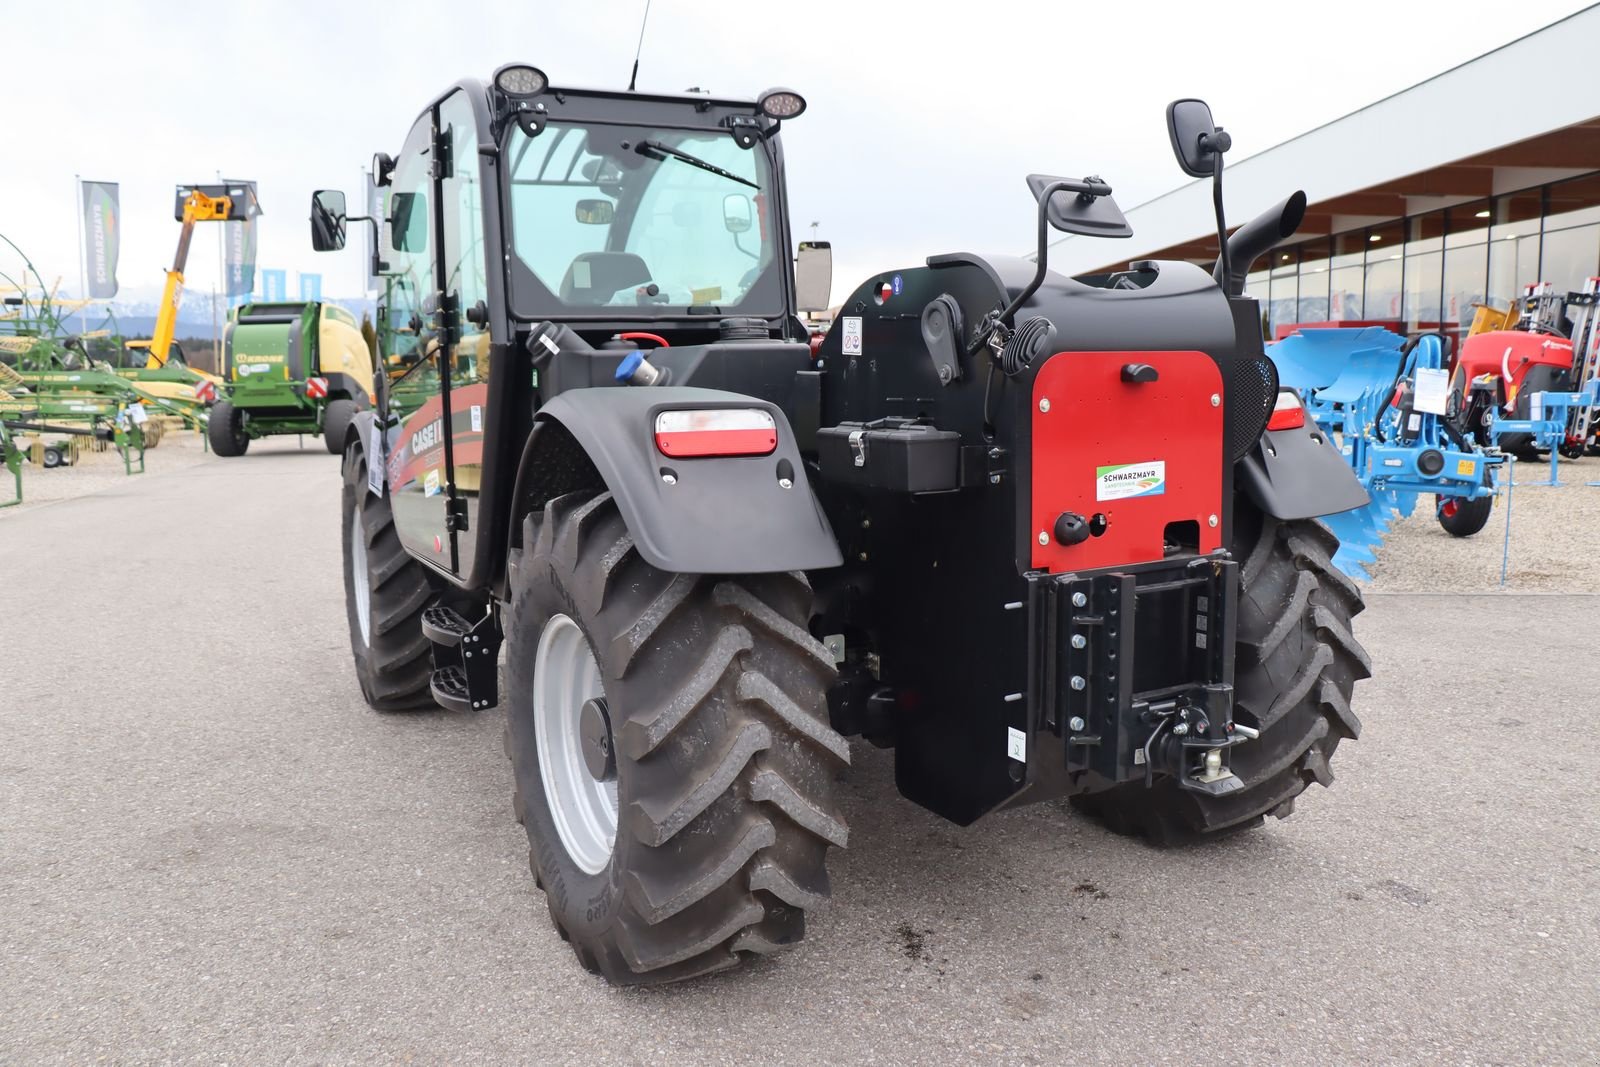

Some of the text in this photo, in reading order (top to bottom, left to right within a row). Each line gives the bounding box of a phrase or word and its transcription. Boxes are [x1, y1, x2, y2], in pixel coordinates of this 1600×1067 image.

[93, 204, 106, 284] SCHWARZMAYR
[233, 221, 244, 284] SCHWARZM
[247, 354, 284, 363] KRONE
[412, 423, 434, 455] CASE
[1103, 470, 1156, 482] SCHWARZMAYR
